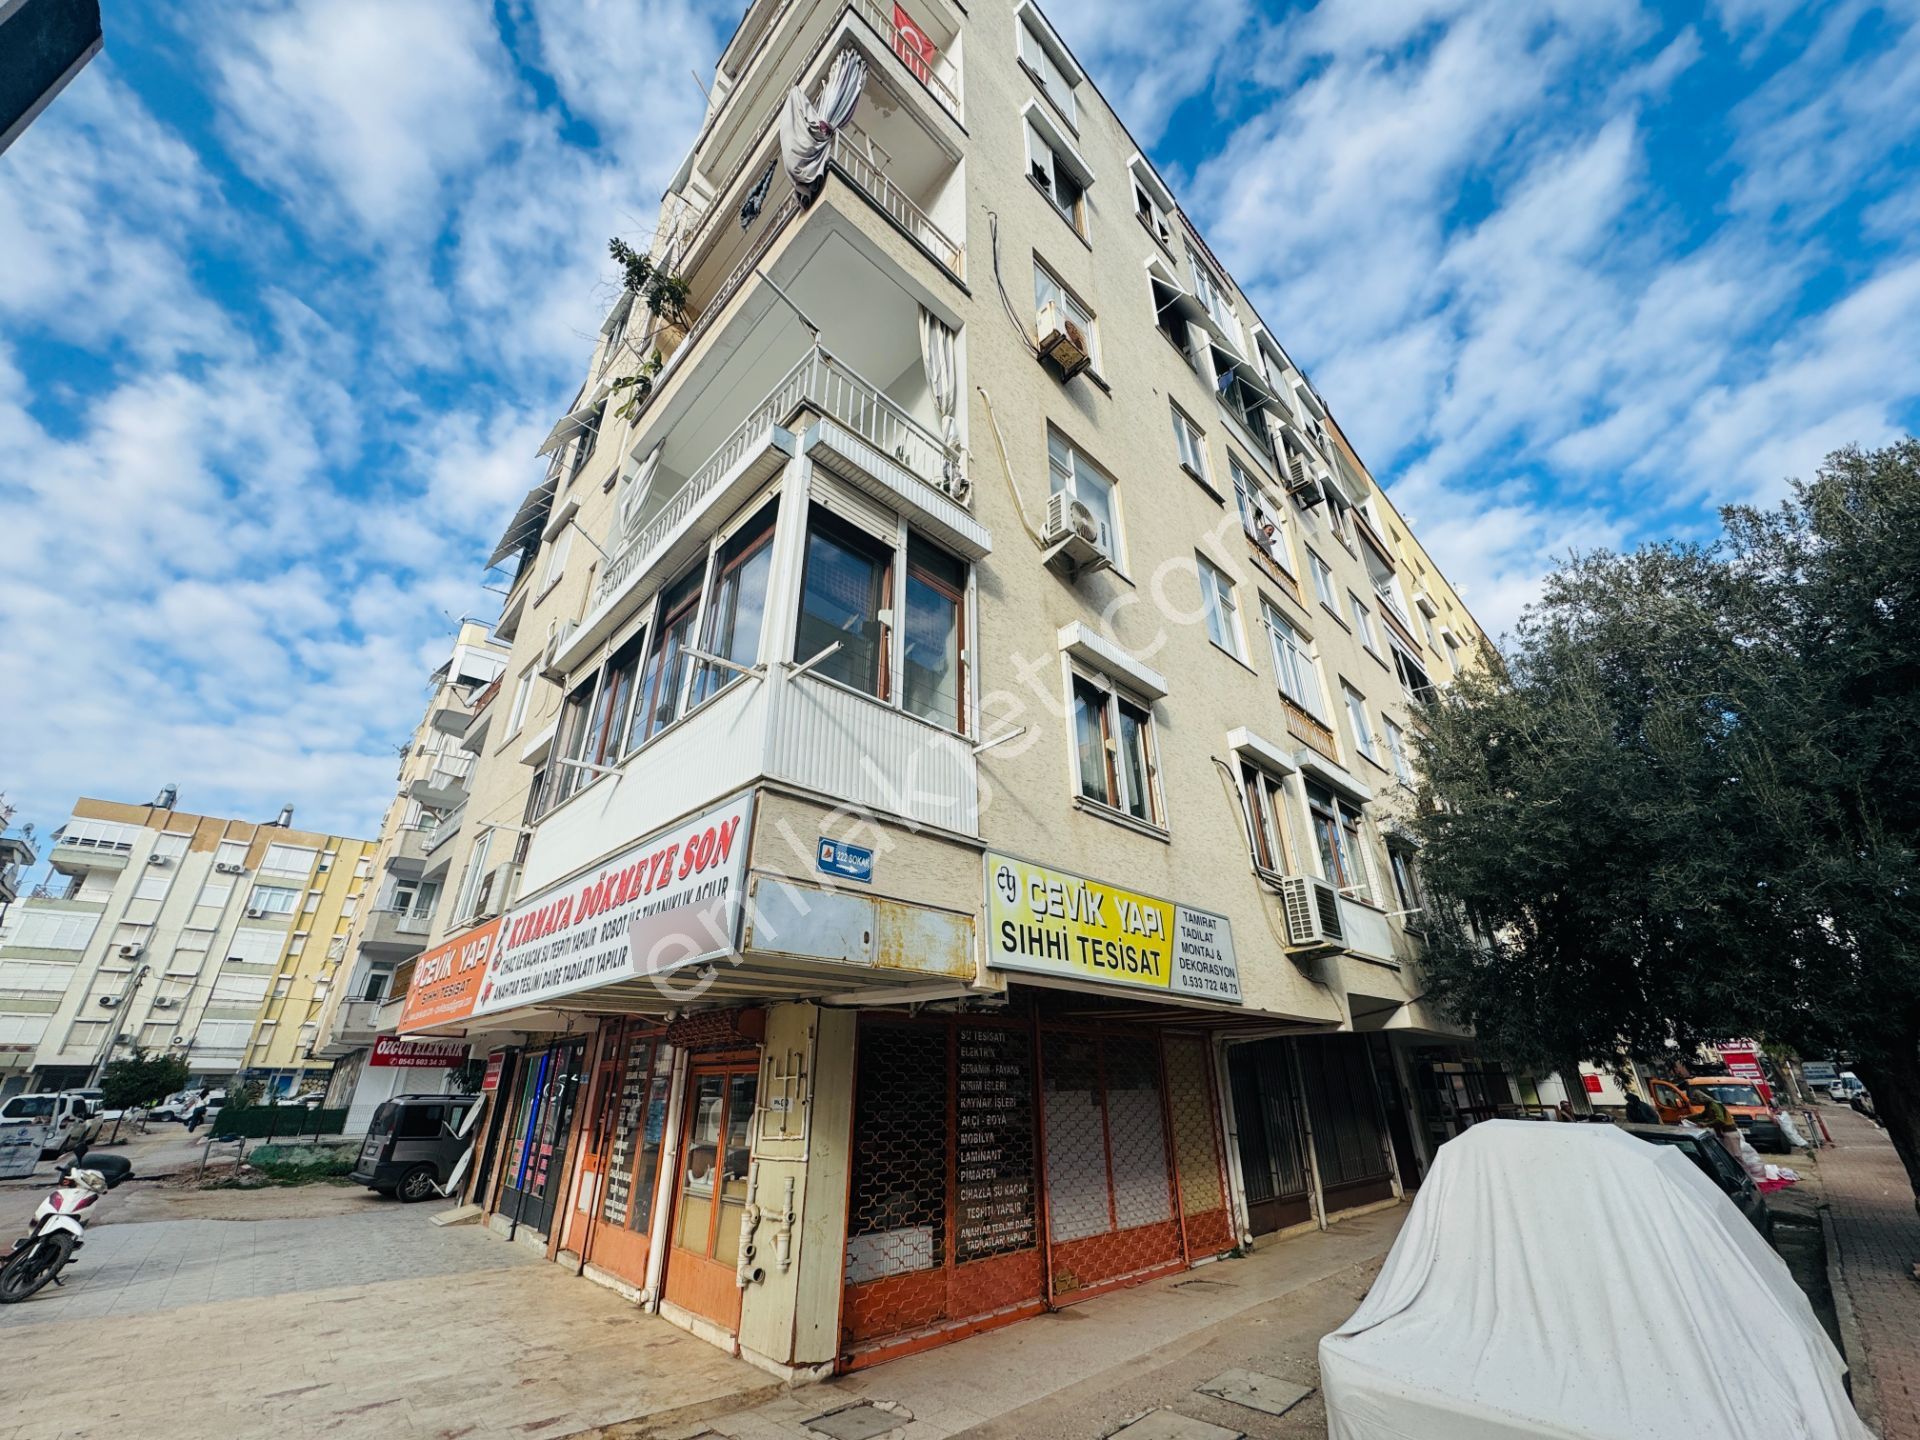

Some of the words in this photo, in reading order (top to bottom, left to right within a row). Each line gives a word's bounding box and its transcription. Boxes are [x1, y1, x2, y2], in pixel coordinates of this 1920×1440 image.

[837, 851, 848, 862] 222
[507, 894, 574, 951] KIRMAYA
[573, 842, 679, 926] DÖKMEYE
[678, 815, 741, 880] SON
[1028, 875, 1107, 929] ÇEVİK
[1114, 896, 1166, 941] YAPI
[571, 926, 597, 953] YAPILIR
[600, 913, 628, 943] ROBOT
[1181, 926, 1213, 943] TADİLAT
[1001, 920, 1069, 962] SIHHİ
[1077, 936, 1160, 977] TESİSAT
[1181, 942, 1214, 959] MONTAJ
[1217, 950, 1222, 961] &
[419, 945, 457, 995] ÇEVİK
[458, 934, 494, 975] YAPI
[492, 979, 520, 1001] ANAHTAR
[562, 955, 596, 985] TADİLATI
[596, 945, 628, 973] YAPILIR
[1179, 957, 1235, 978] DEKORASYON
[1182, 975, 1203, 989] 0.533
[1205, 978, 1217, 991] 722
[1220, 981, 1228, 993] 48
[1230, 983, 1237, 994] 73
[993, 1185, 1003, 1197] SU
